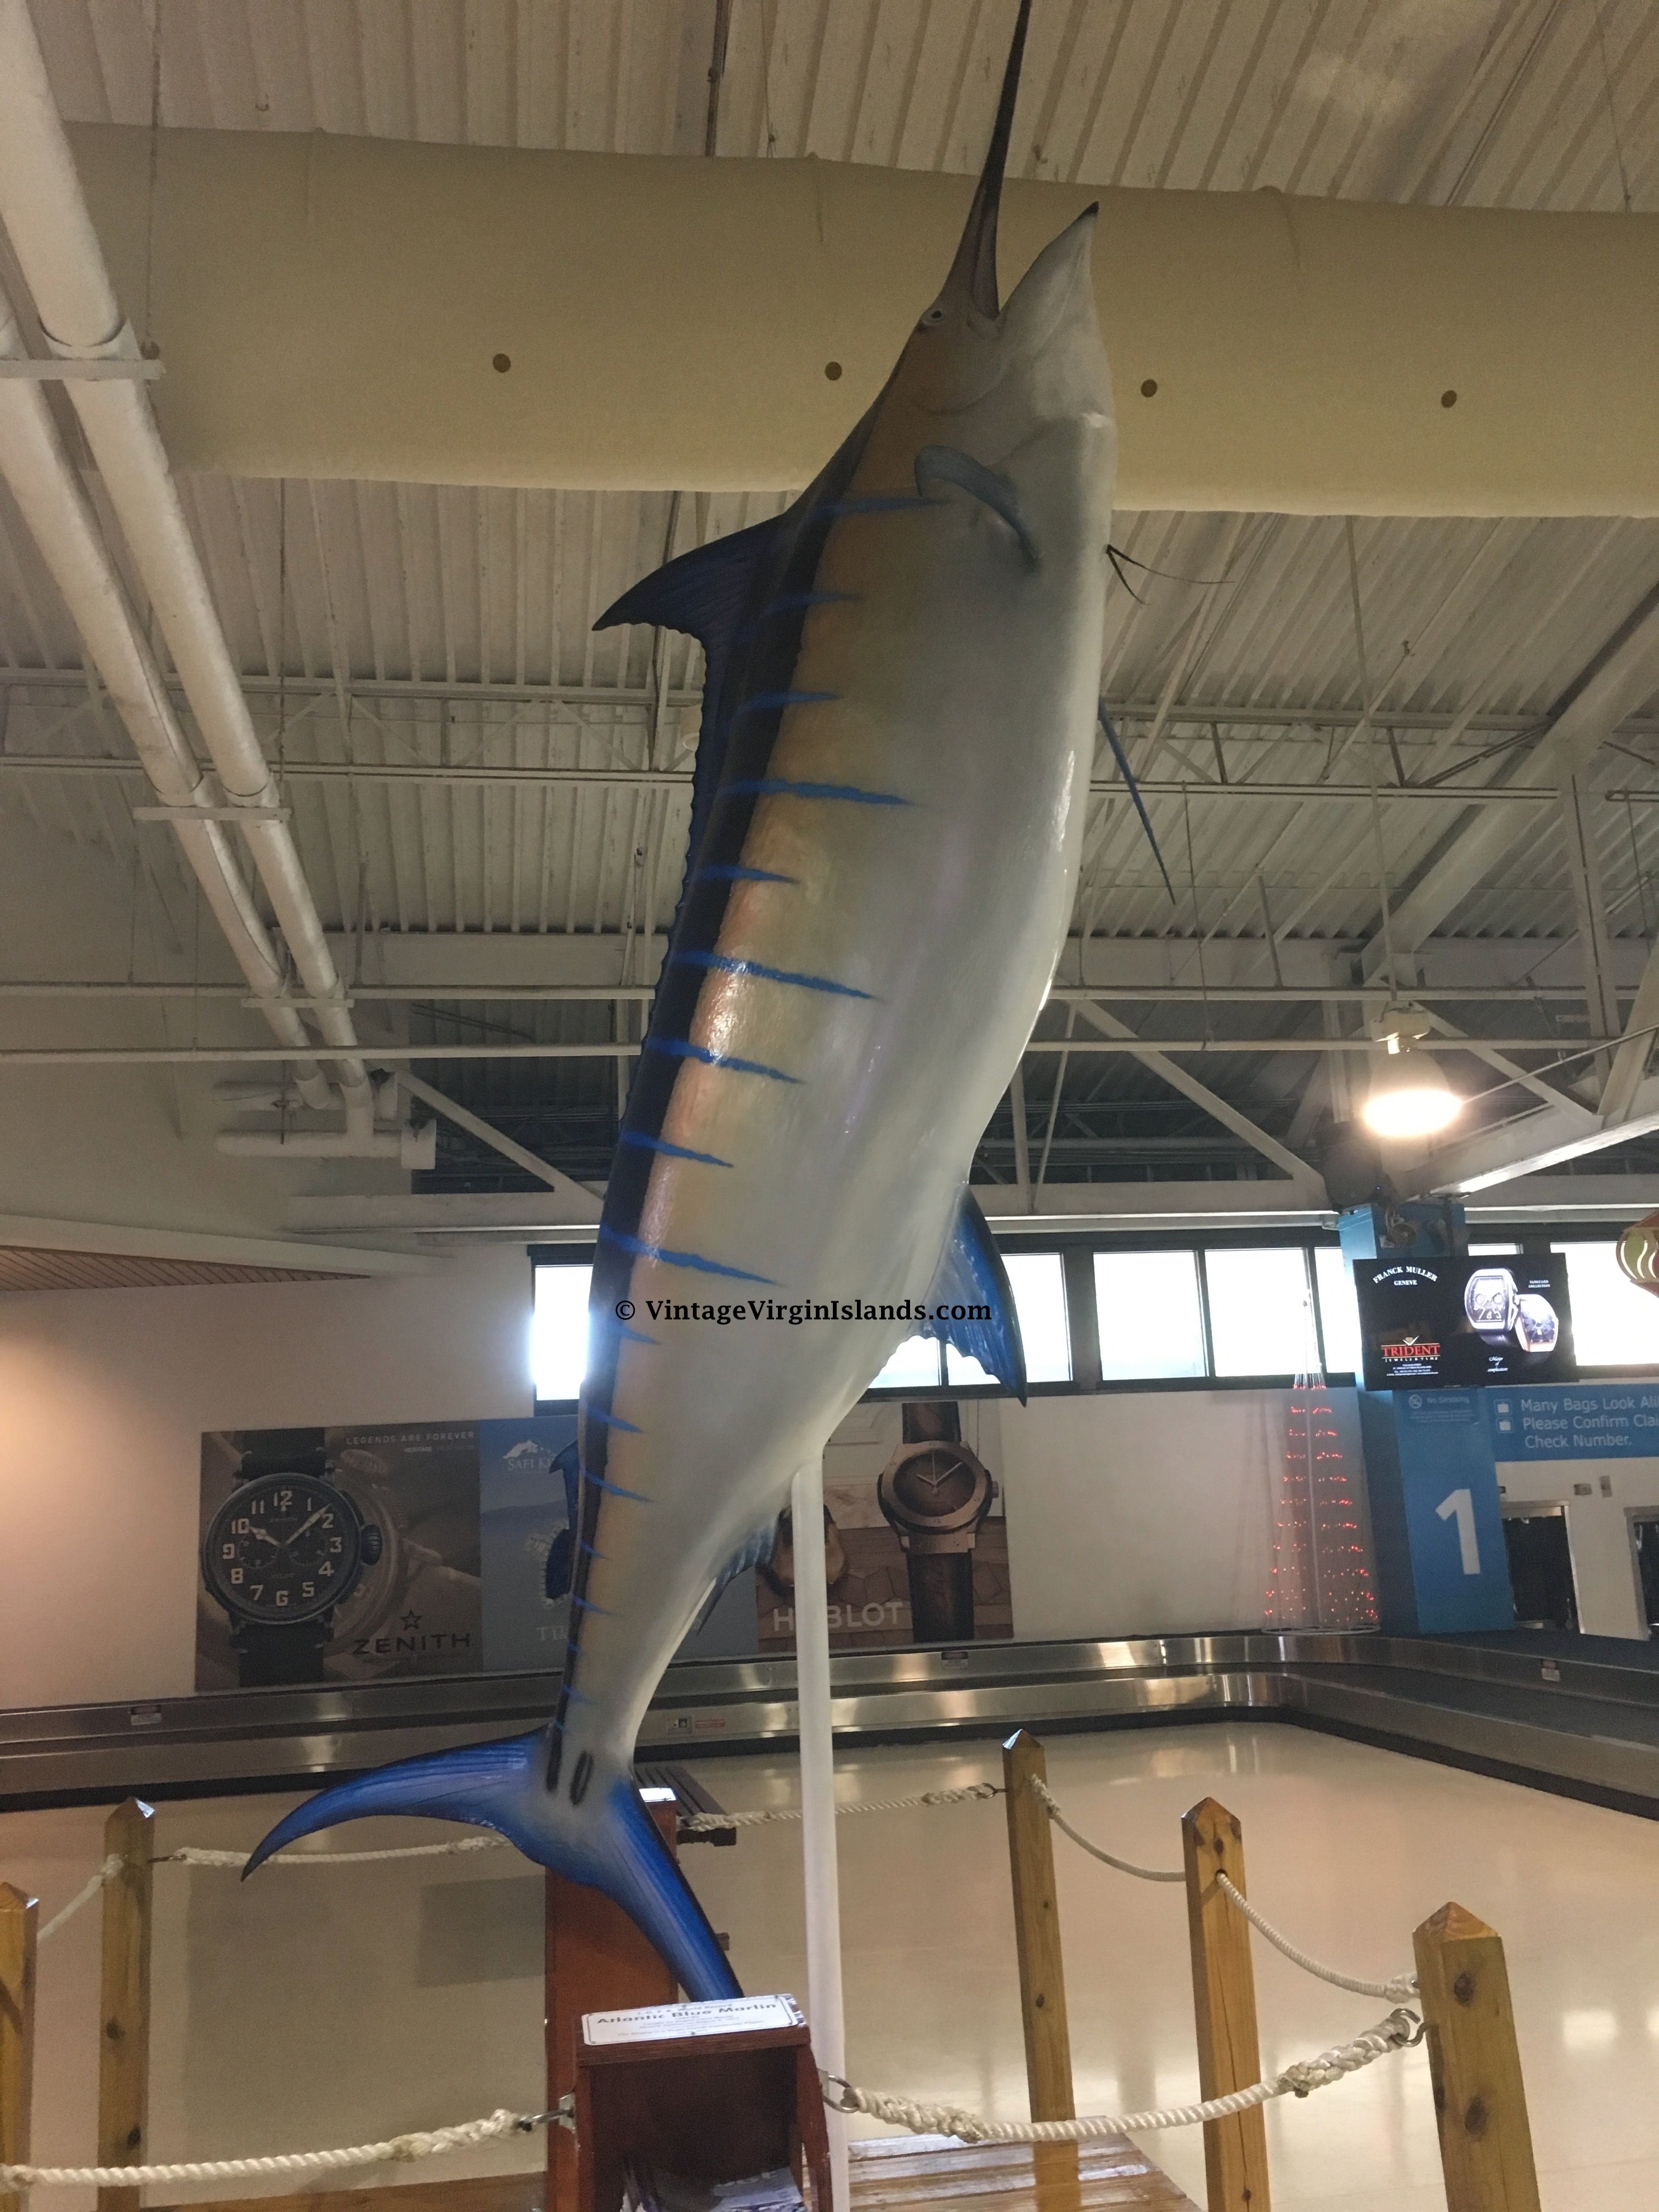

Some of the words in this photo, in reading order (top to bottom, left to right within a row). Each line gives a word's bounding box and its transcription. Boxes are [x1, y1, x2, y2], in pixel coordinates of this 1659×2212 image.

[1373, 1267, 1403, 1284] FRANCK
[1406, 1266, 1438, 1282] MULLER
[1382, 1345, 1440, 1356] TRIDENT
[1521, 1399, 1558, 1414] Many
[1564, 1398, 1598, 1413] Bags
[1602, 1396, 1635, 1409] Look
[1640, 1395, 1659, 1408] Ali
[1523, 1417, 1568, 1430] Please
[1573, 1415, 1629, 1429] Confirm
[1633, 1414, 1659, 1427] Clai
[346, 1435, 397, 1444] LEGENDS
[401, 1434, 421, 1442] ARE
[426, 1431, 474, 1441] FOREVER
[1525, 1435, 1568, 1448] Check
[1573, 1434, 1633, 1447] Number.
[251, 1499, 265, 1515] 11
[274, 1490, 292, 1507] 12
[231, 1518, 250, 1534] 10
[1435, 1488, 1481, 1575] 1
[223, 1543, 235, 1560] 9
[330, 1537, 342, 1553] 3
[231, 1567, 244, 1584] 8
[318, 1561, 335, 1577] 4
[250, 1584, 263, 1601] 7
[302, 1582, 315, 1598] 5
[773, 1601, 903, 1632] HBLOT
[352, 1633, 471, 1655] ZENITH
[597, 2015, 665, 2024] Atlantic
[719, 2004, 776, 2013] Marlin
